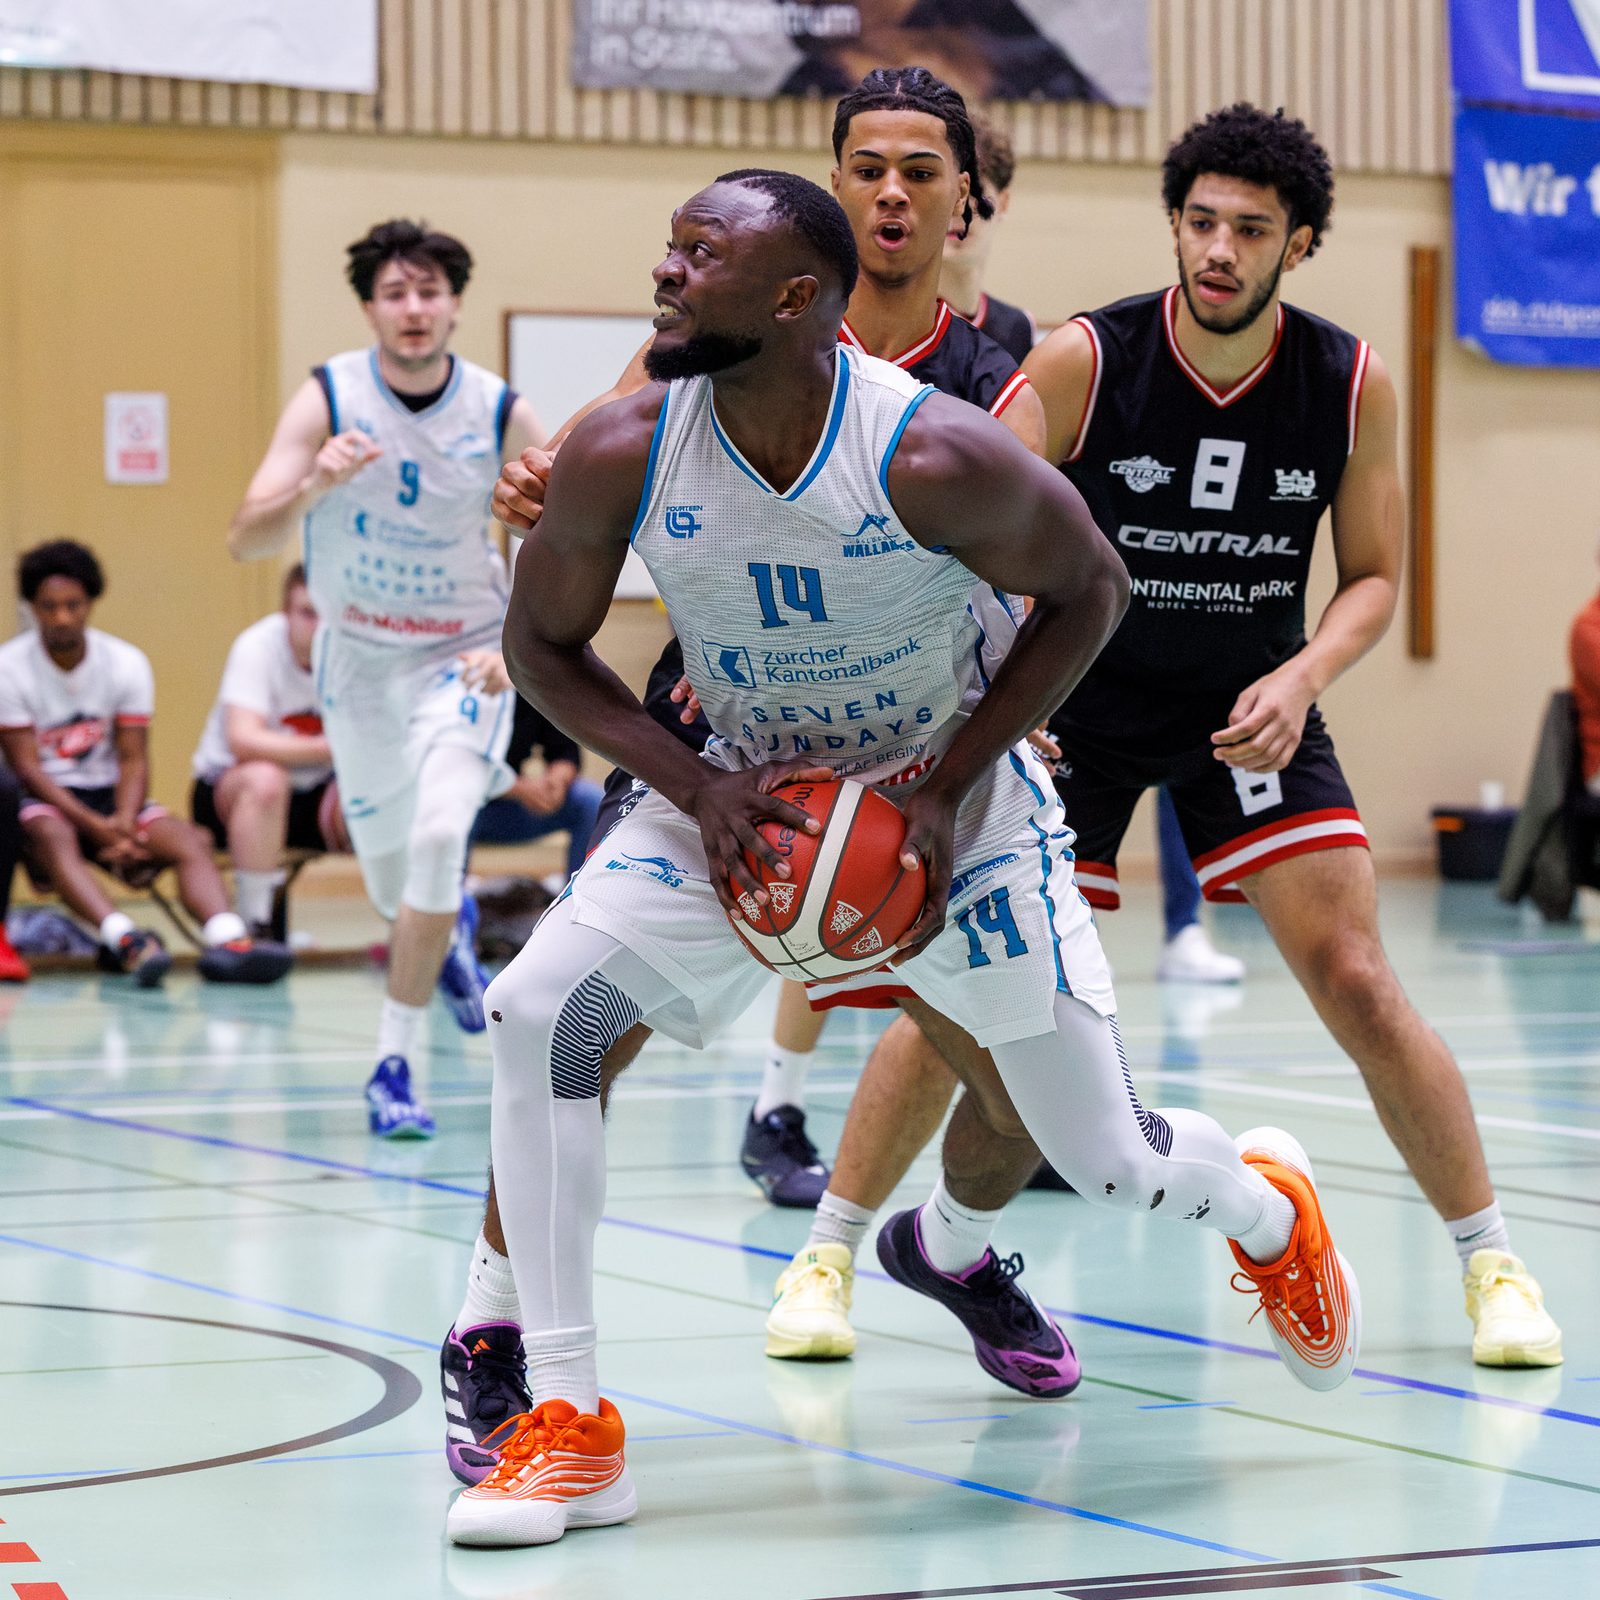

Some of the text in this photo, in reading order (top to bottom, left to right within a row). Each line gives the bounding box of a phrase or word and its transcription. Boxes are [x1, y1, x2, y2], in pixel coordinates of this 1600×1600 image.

[1483, 158, 1577, 217] Wir
[396, 460, 420, 507] 9
[1108, 460, 1171, 481] CENTRAL
[1190, 438, 1247, 511] 8
[1116, 523, 1300, 558] CENTRAL
[747, 562, 834, 629] 14
[1129, 578, 1297, 602] NTINENTAL PARK
[1147, 601, 1254, 614] HOTEL LUZERN
[761, 644, 848, 666] Zürcher
[765, 637, 923, 683] Kantonalbank
[459, 694, 480, 725] 9
[751, 690, 899, 724] SEVEN
[742, 706, 934, 753] SUNDAYS
[954, 885, 1029, 969] 14
